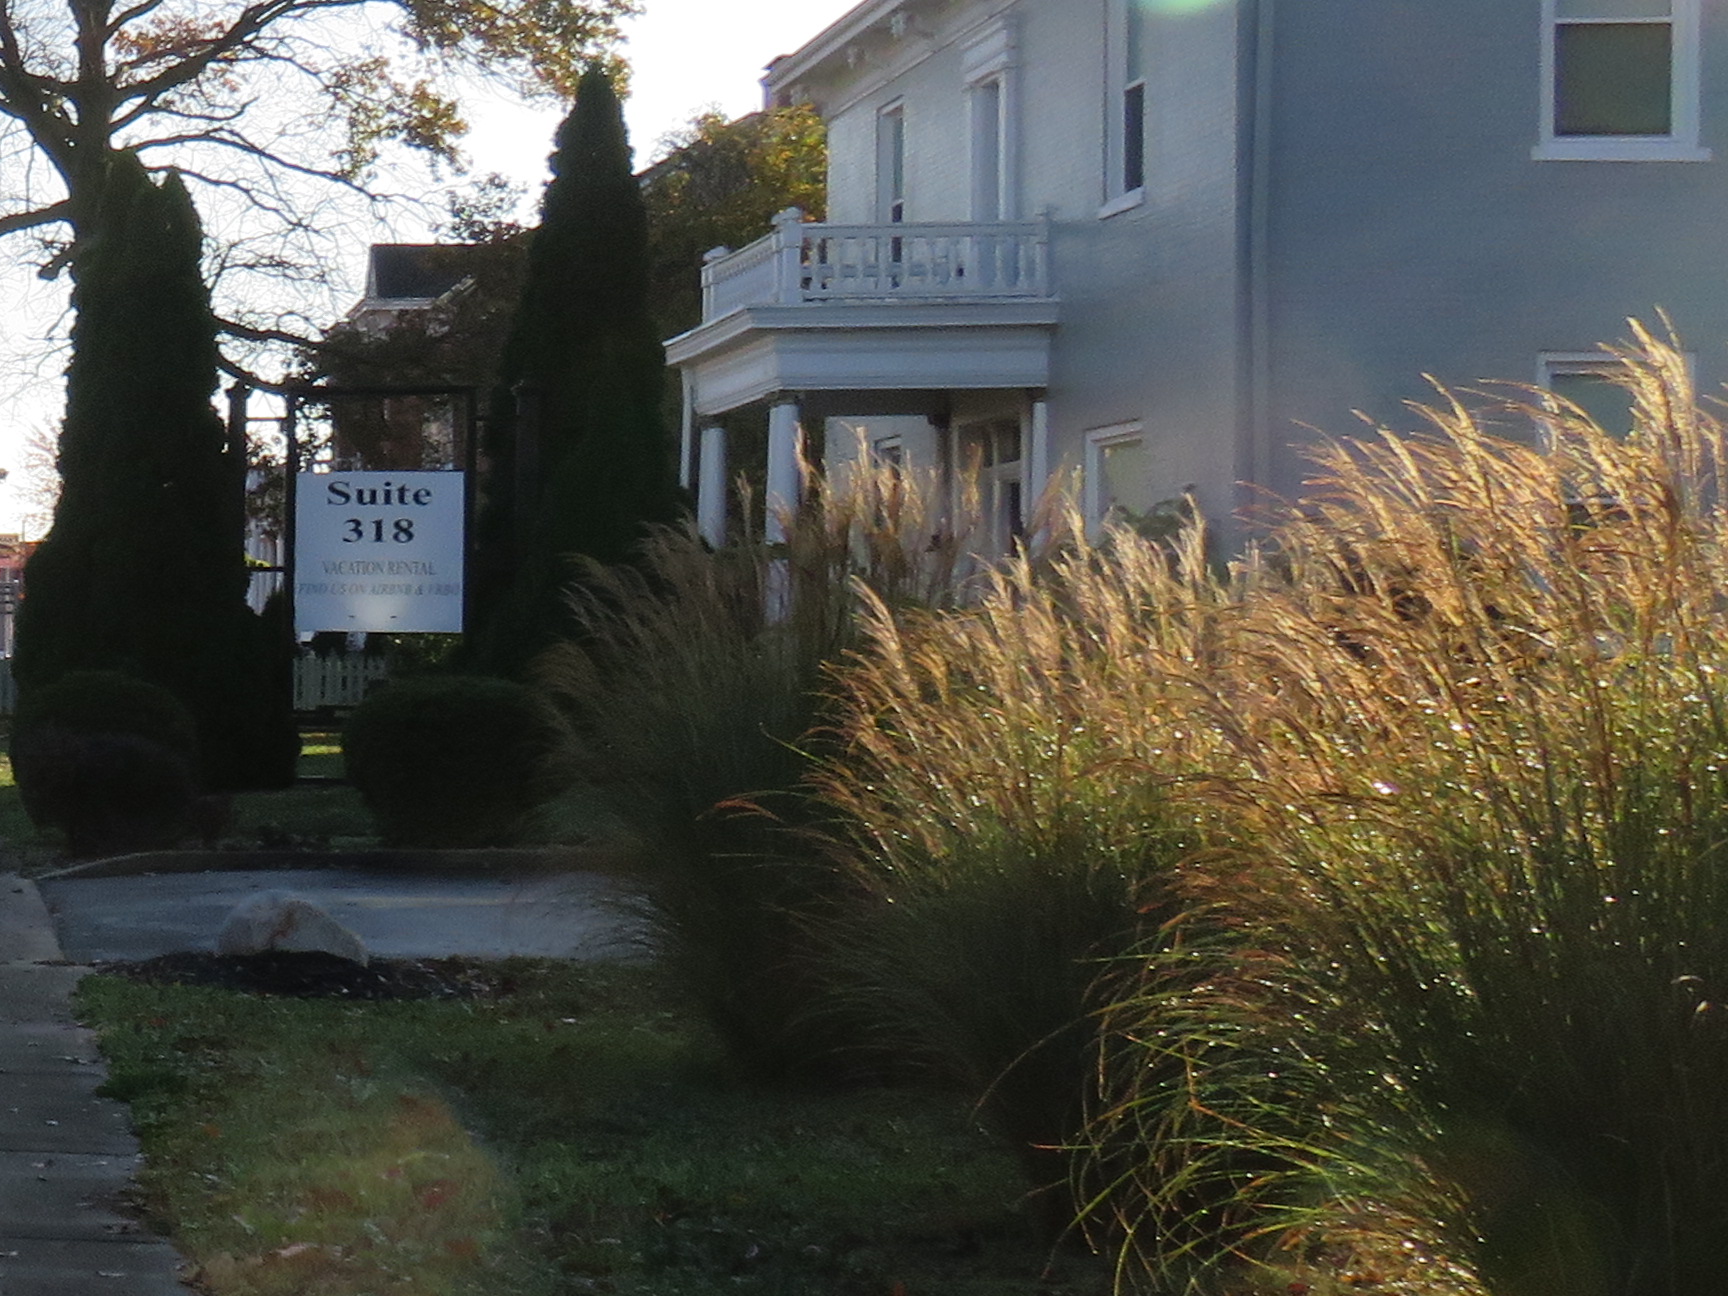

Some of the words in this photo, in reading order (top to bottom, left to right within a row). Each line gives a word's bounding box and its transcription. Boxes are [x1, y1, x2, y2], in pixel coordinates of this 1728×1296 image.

[327, 481, 432, 506] Suite
[343, 518, 415, 543] 318
[322, 560, 385, 575] VACATION
[387, 560, 437, 576] RENTAL
